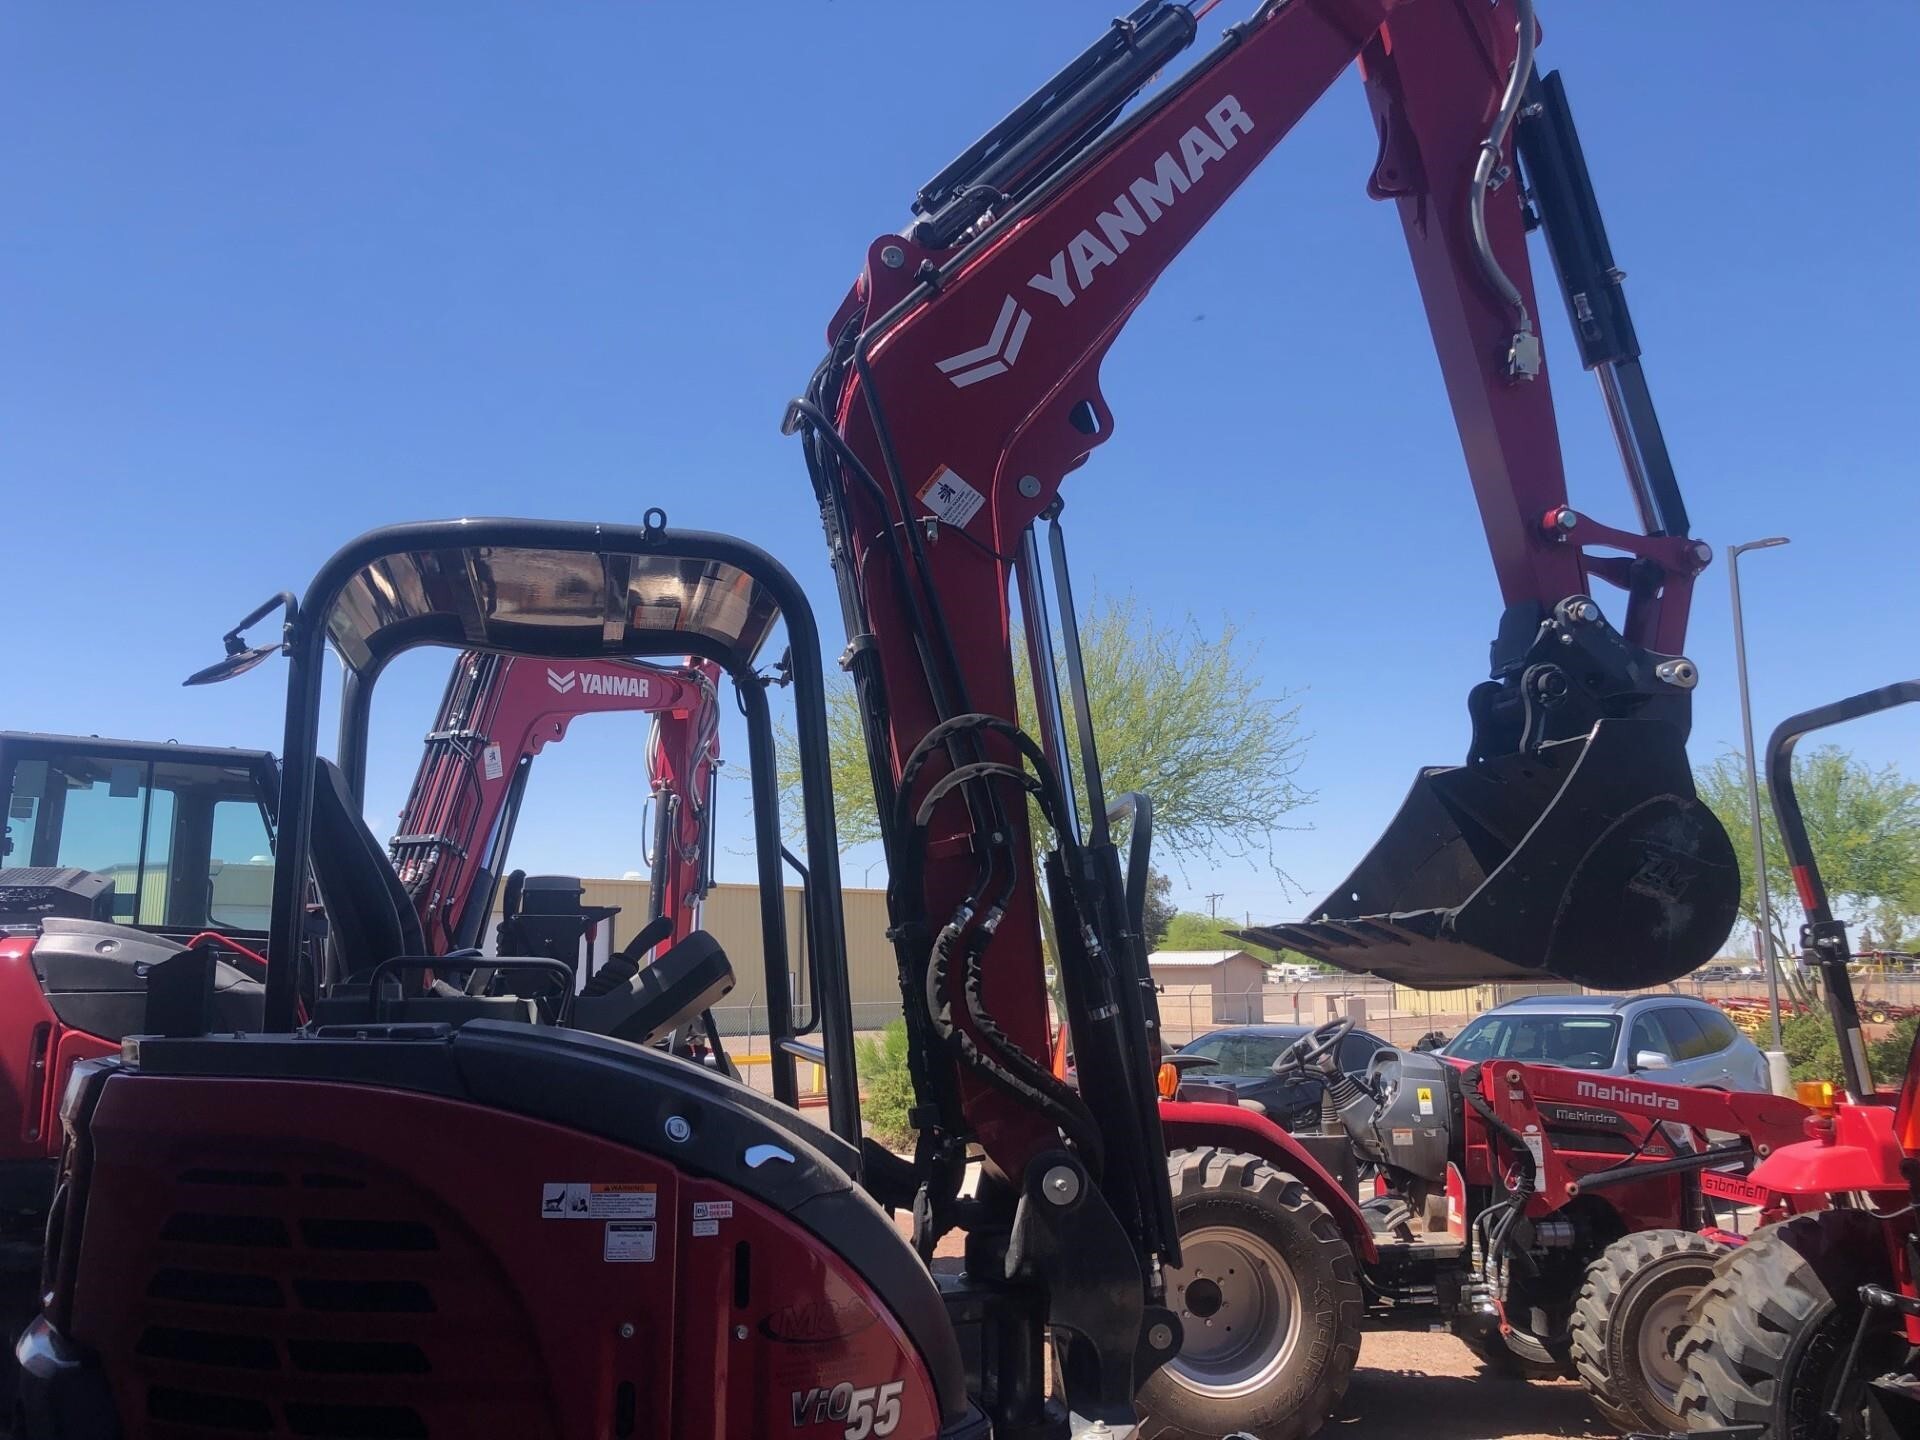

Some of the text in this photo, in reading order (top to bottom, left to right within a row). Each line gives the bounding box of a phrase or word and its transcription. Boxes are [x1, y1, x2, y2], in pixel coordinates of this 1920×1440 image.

[1027, 94, 1255, 307] YANMAR
[579, 672, 649, 698] YANMAR
[1577, 1080, 1679, 1111] Mahindra
[1556, 1109, 1617, 1124] Mahindra
